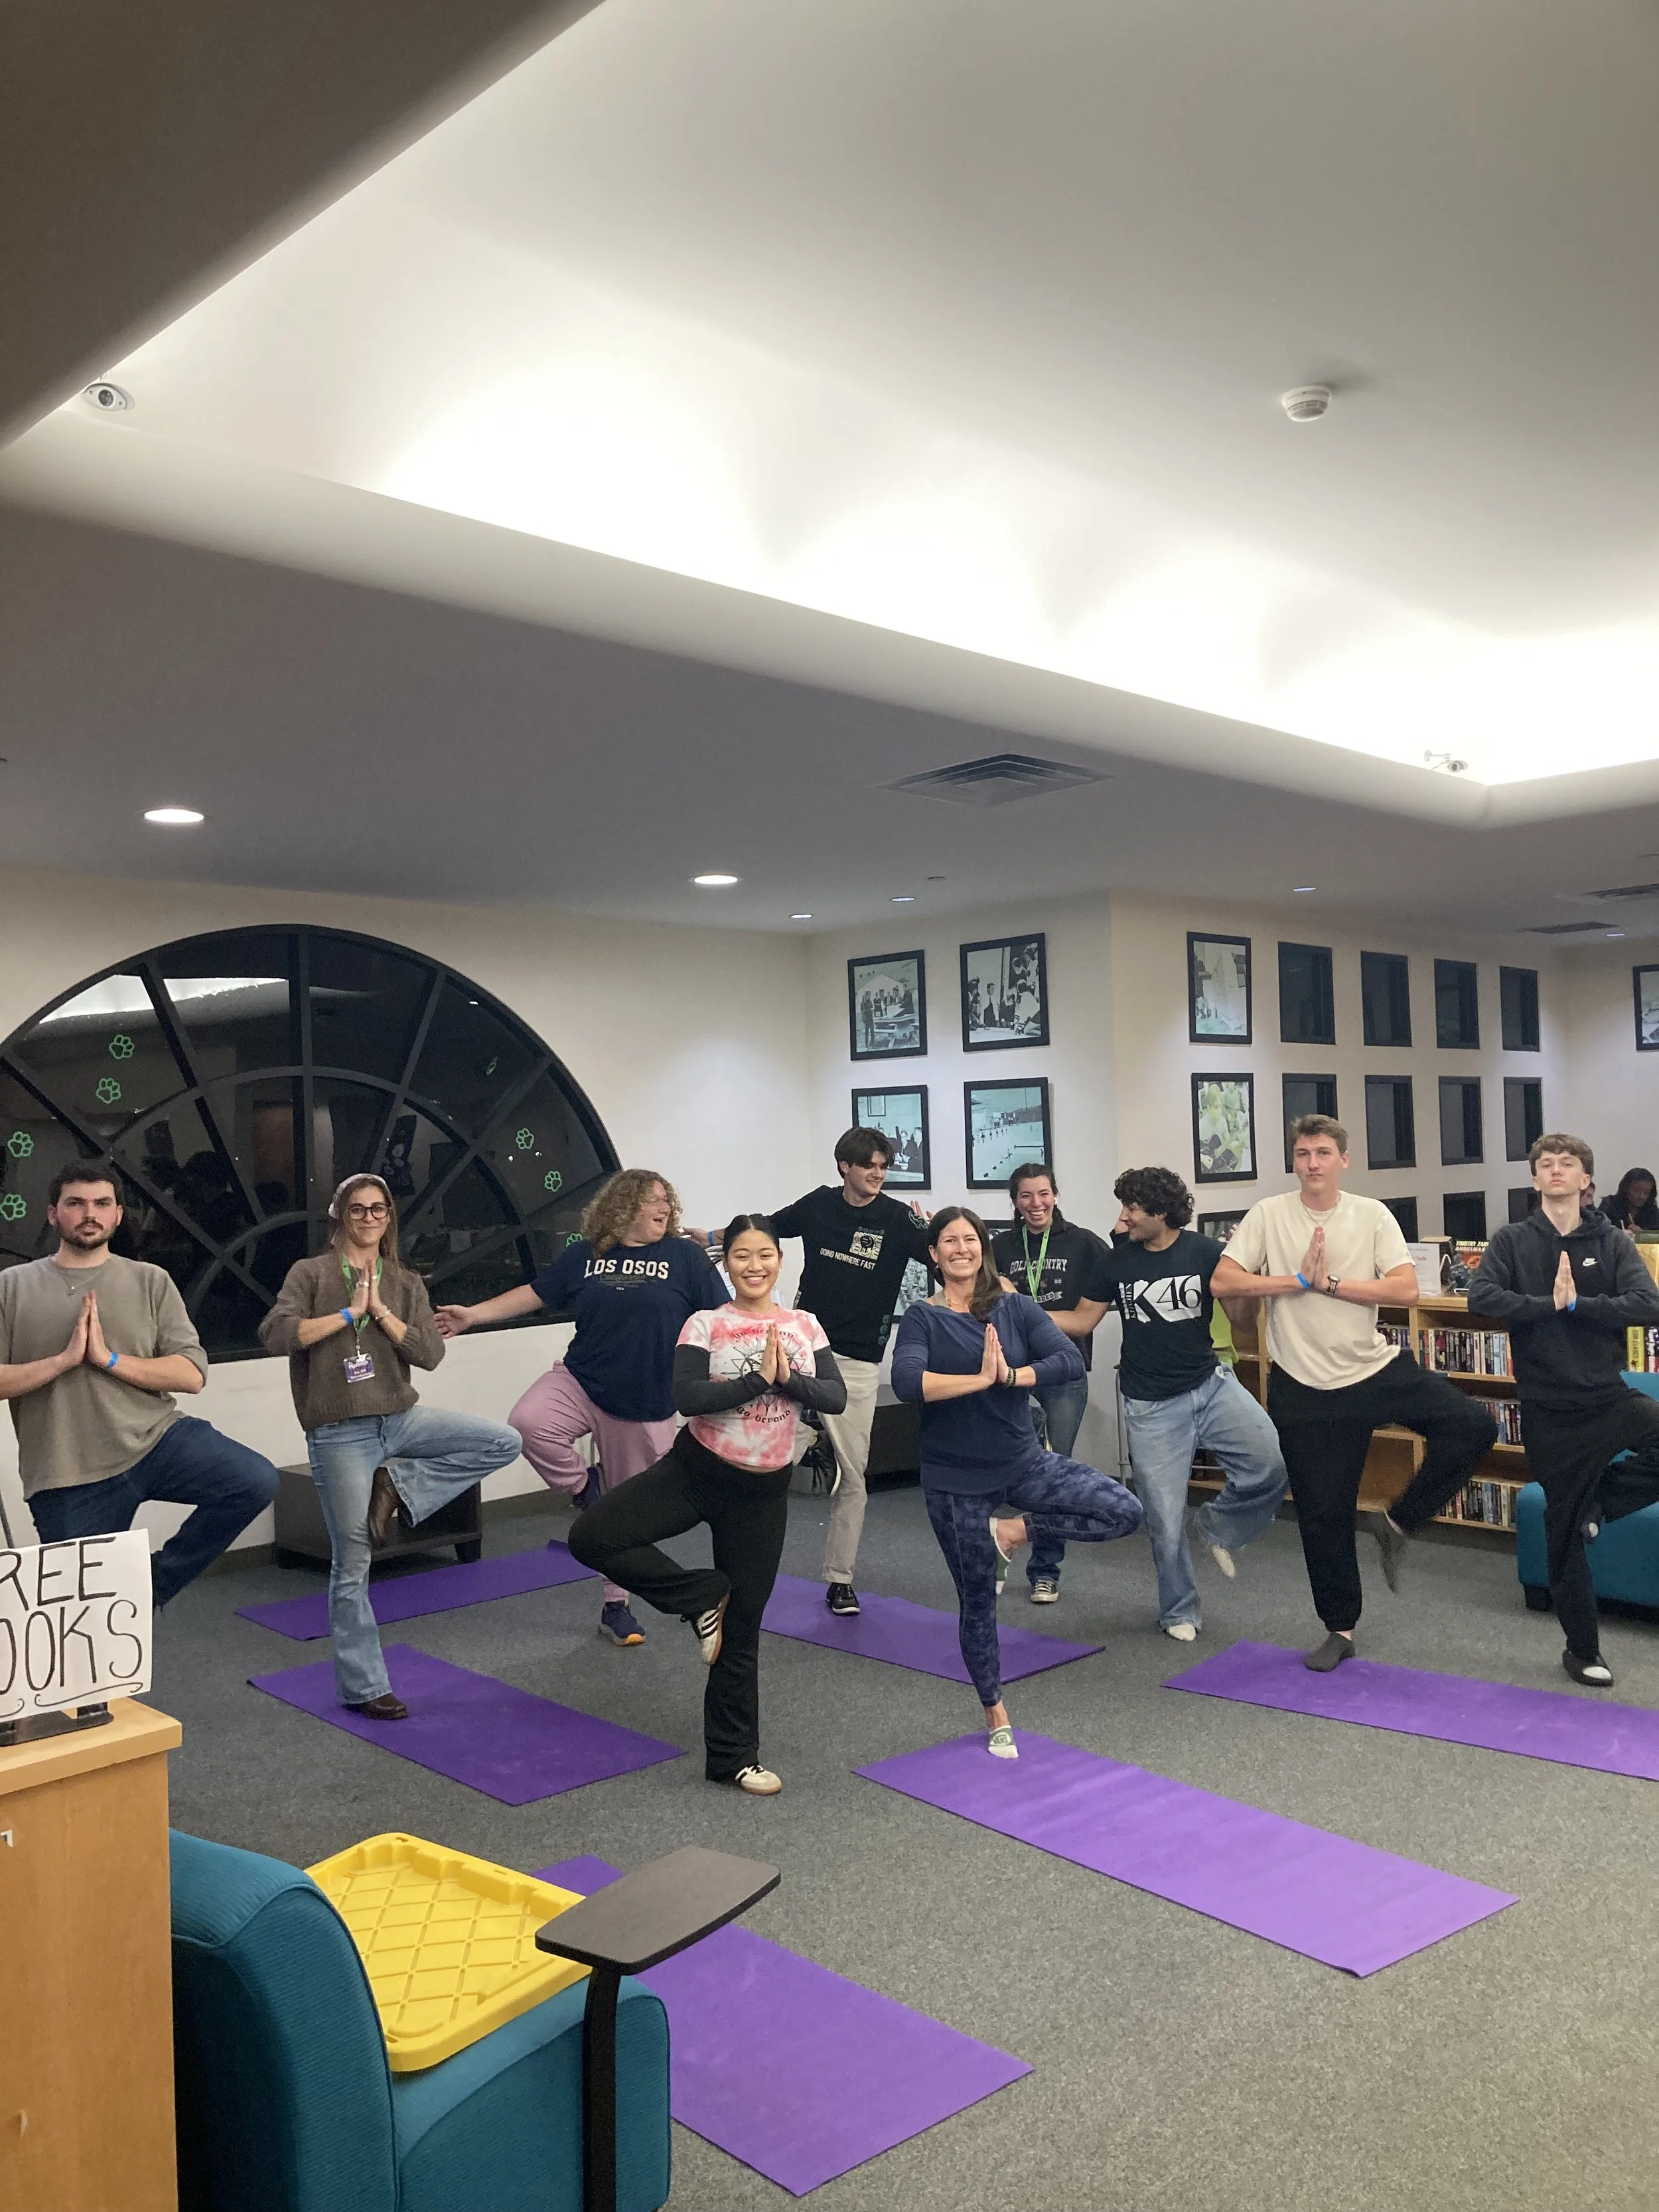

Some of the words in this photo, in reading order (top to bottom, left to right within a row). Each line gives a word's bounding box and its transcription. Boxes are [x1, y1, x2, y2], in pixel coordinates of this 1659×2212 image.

[584, 1259, 617, 1278] LOS
[622, 1259, 670, 1280] OSOS
[820, 1248, 835, 1258] GOING
[834, 1252, 861, 1266] NOWHERE
[860, 1260, 876, 1271] FAST
[1010, 1260, 1027, 1274] GOL
[1031, 1258, 1068, 1272] CNTRY
[1037, 1292, 1054, 1302] ODEO
[0, 1536, 117, 1611] REE
[0, 1599, 143, 1694] OOKS
